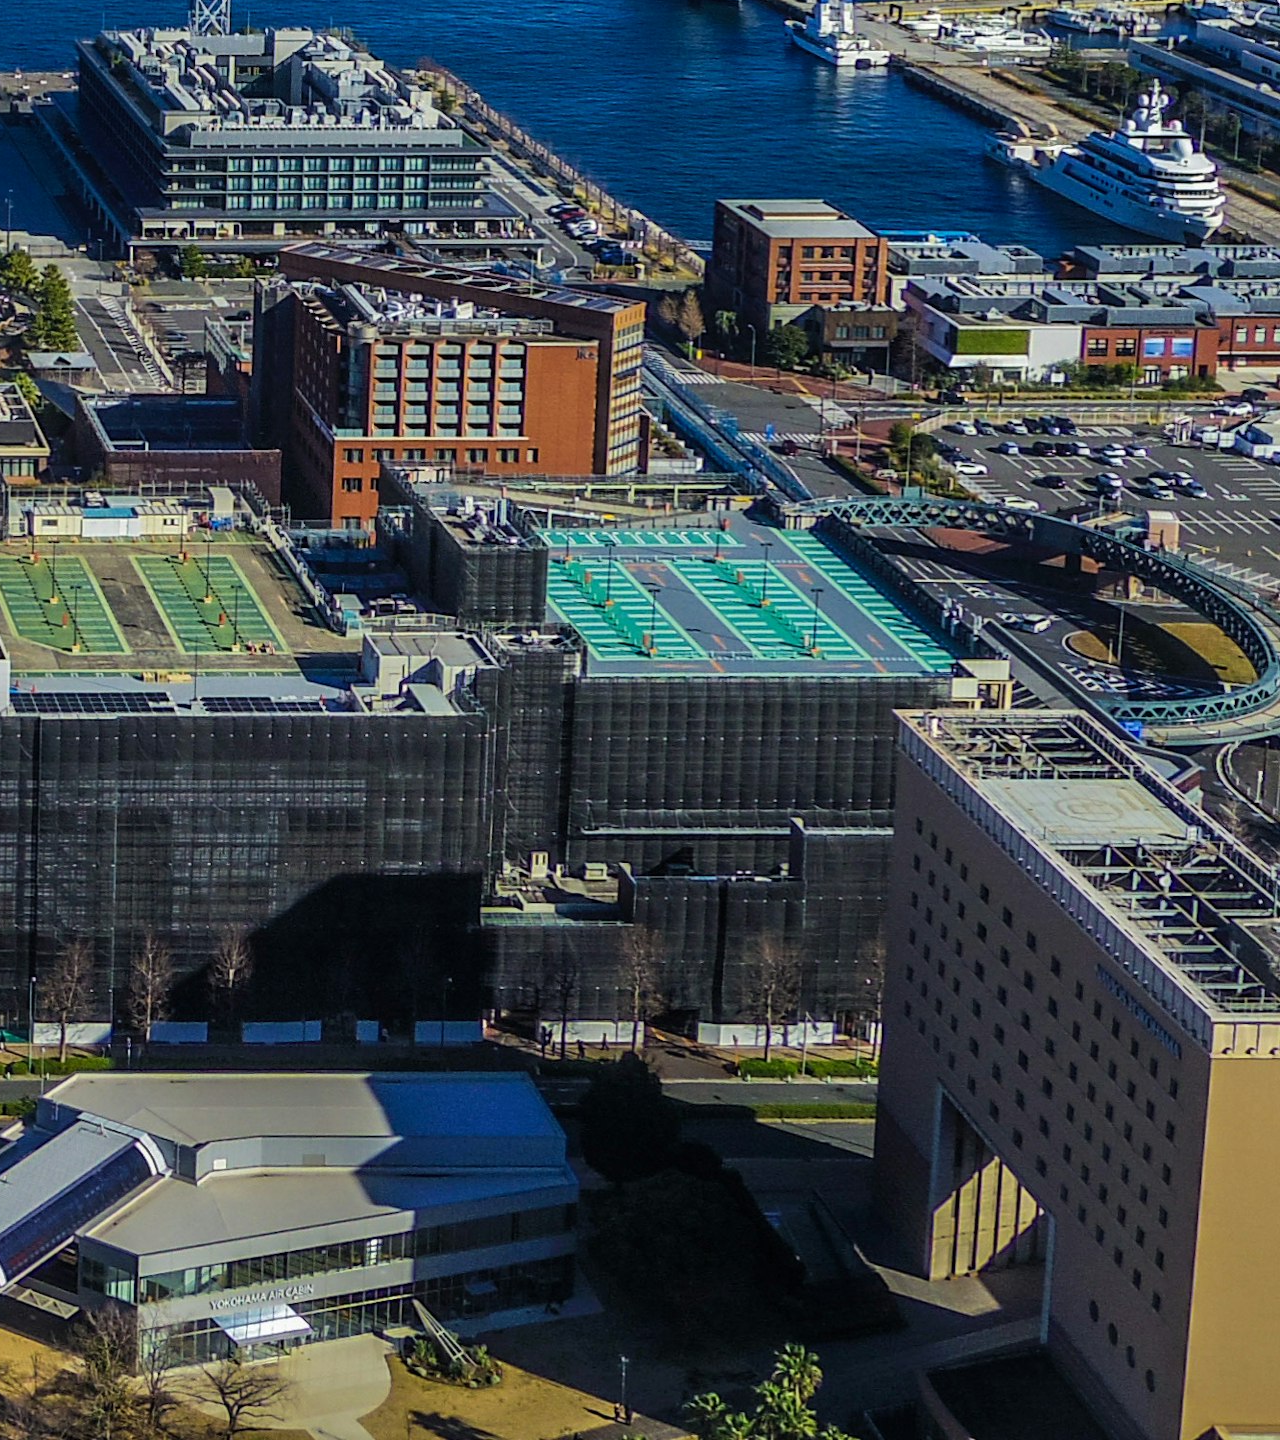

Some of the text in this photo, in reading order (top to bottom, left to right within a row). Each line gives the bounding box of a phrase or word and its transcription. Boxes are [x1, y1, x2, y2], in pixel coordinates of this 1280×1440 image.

[210, 1283, 314, 1310] YOKOHAMA AIR CABIN
